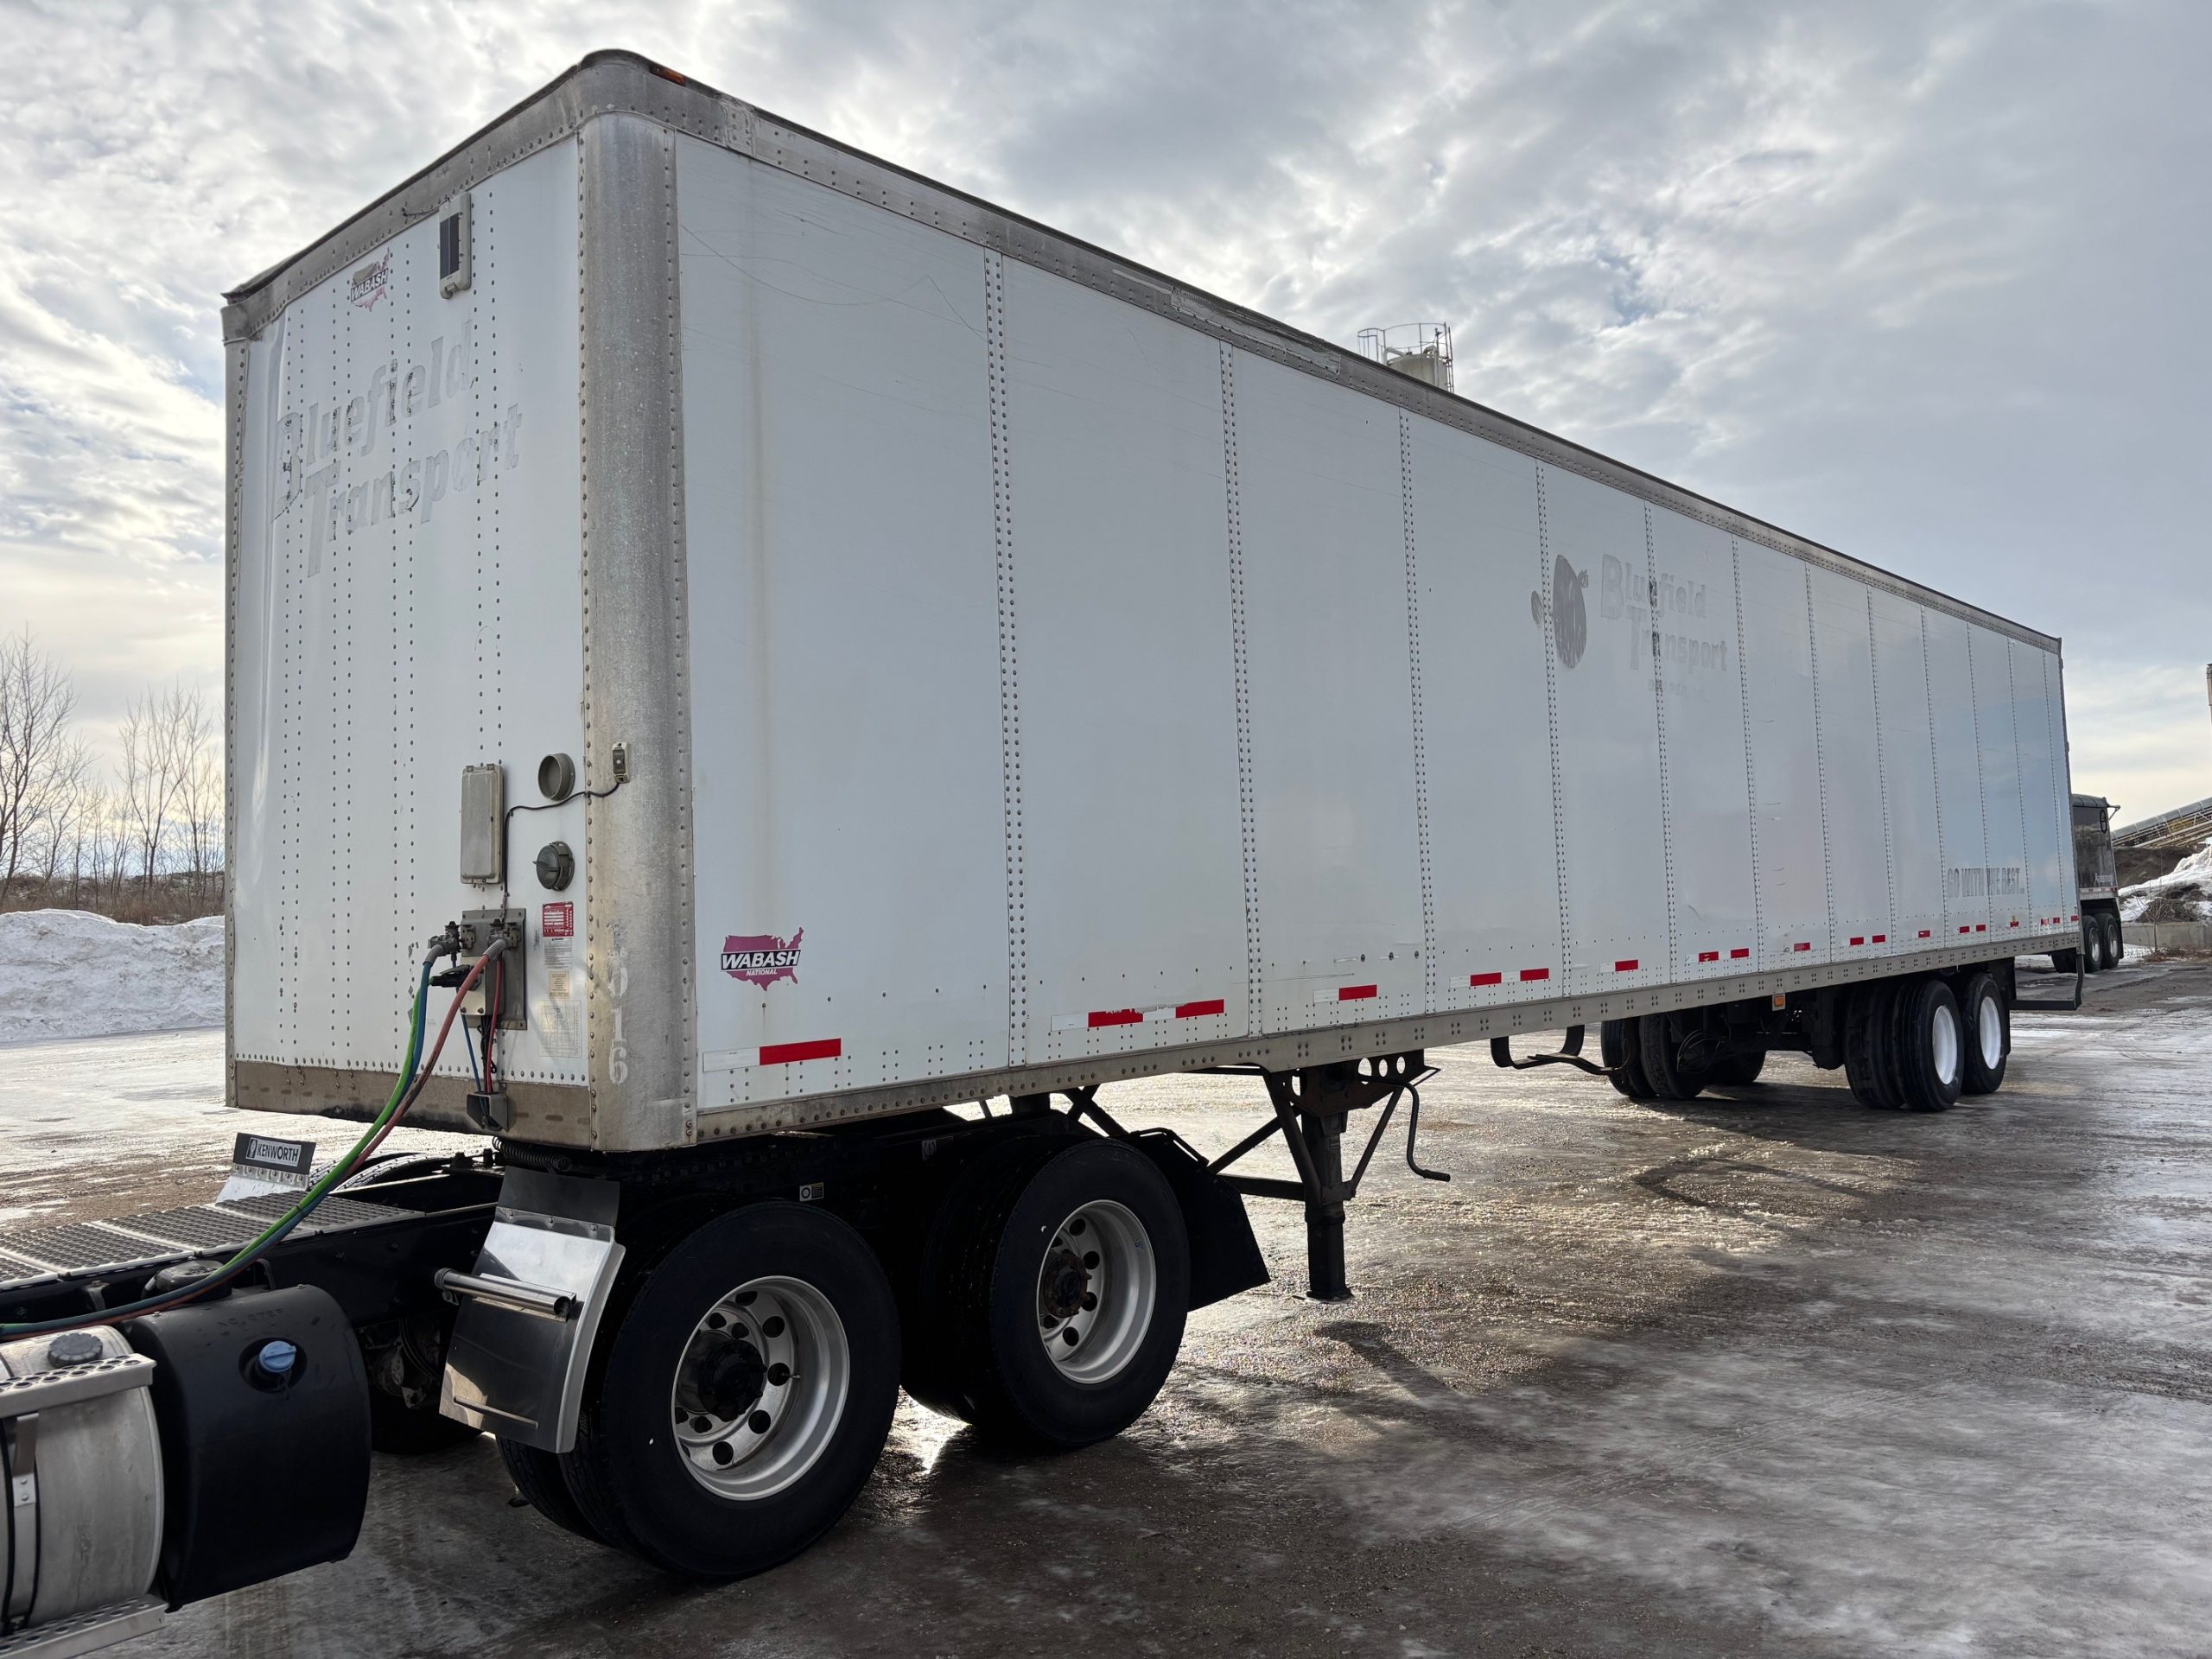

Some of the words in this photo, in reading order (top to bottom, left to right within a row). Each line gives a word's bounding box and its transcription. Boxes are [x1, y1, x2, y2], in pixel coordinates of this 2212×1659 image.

[351, 269, 388, 302] WABASH
[303, 403, 523, 578] Transport
[1600, 554, 1707, 620] Blufield
[1625, 606, 1727, 674] Trnsport
[722, 951, 799, 969] WABASH
[257, 1143, 299, 1162] KENWORTH
